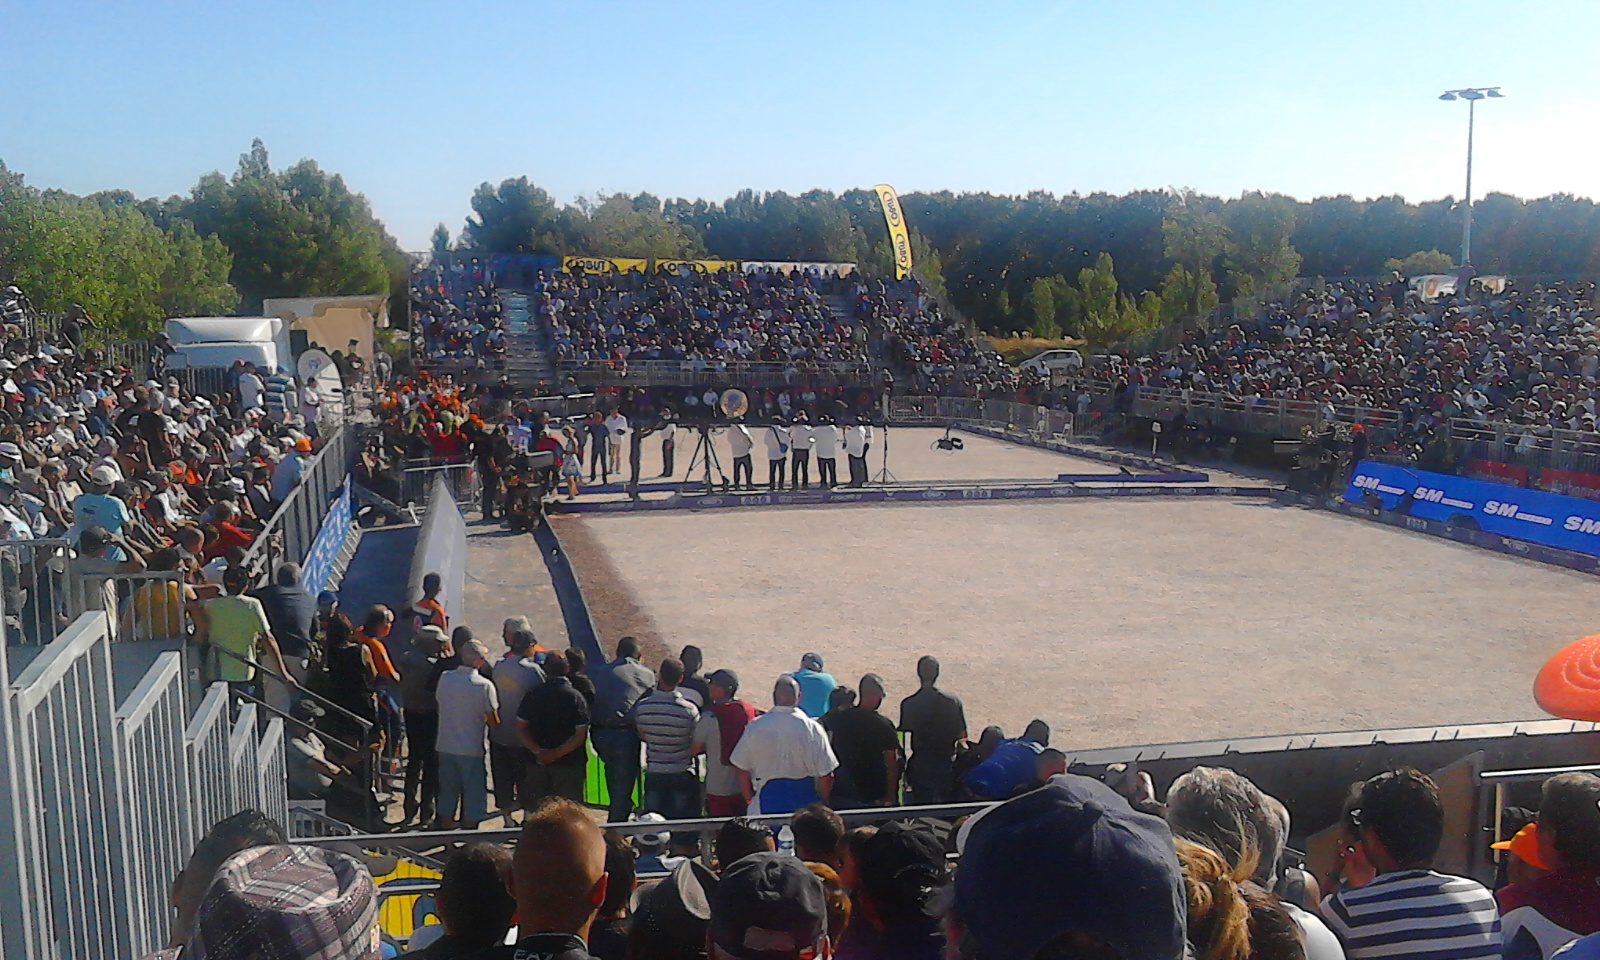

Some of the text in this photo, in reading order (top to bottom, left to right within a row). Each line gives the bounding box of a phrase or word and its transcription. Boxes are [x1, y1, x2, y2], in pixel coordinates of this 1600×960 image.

[1353, 475, 1381, 490] SM
[1413, 487, 1445, 503] SM
[1483, 500, 1519, 518] SM
[1564, 516, 1600, 535] SM
